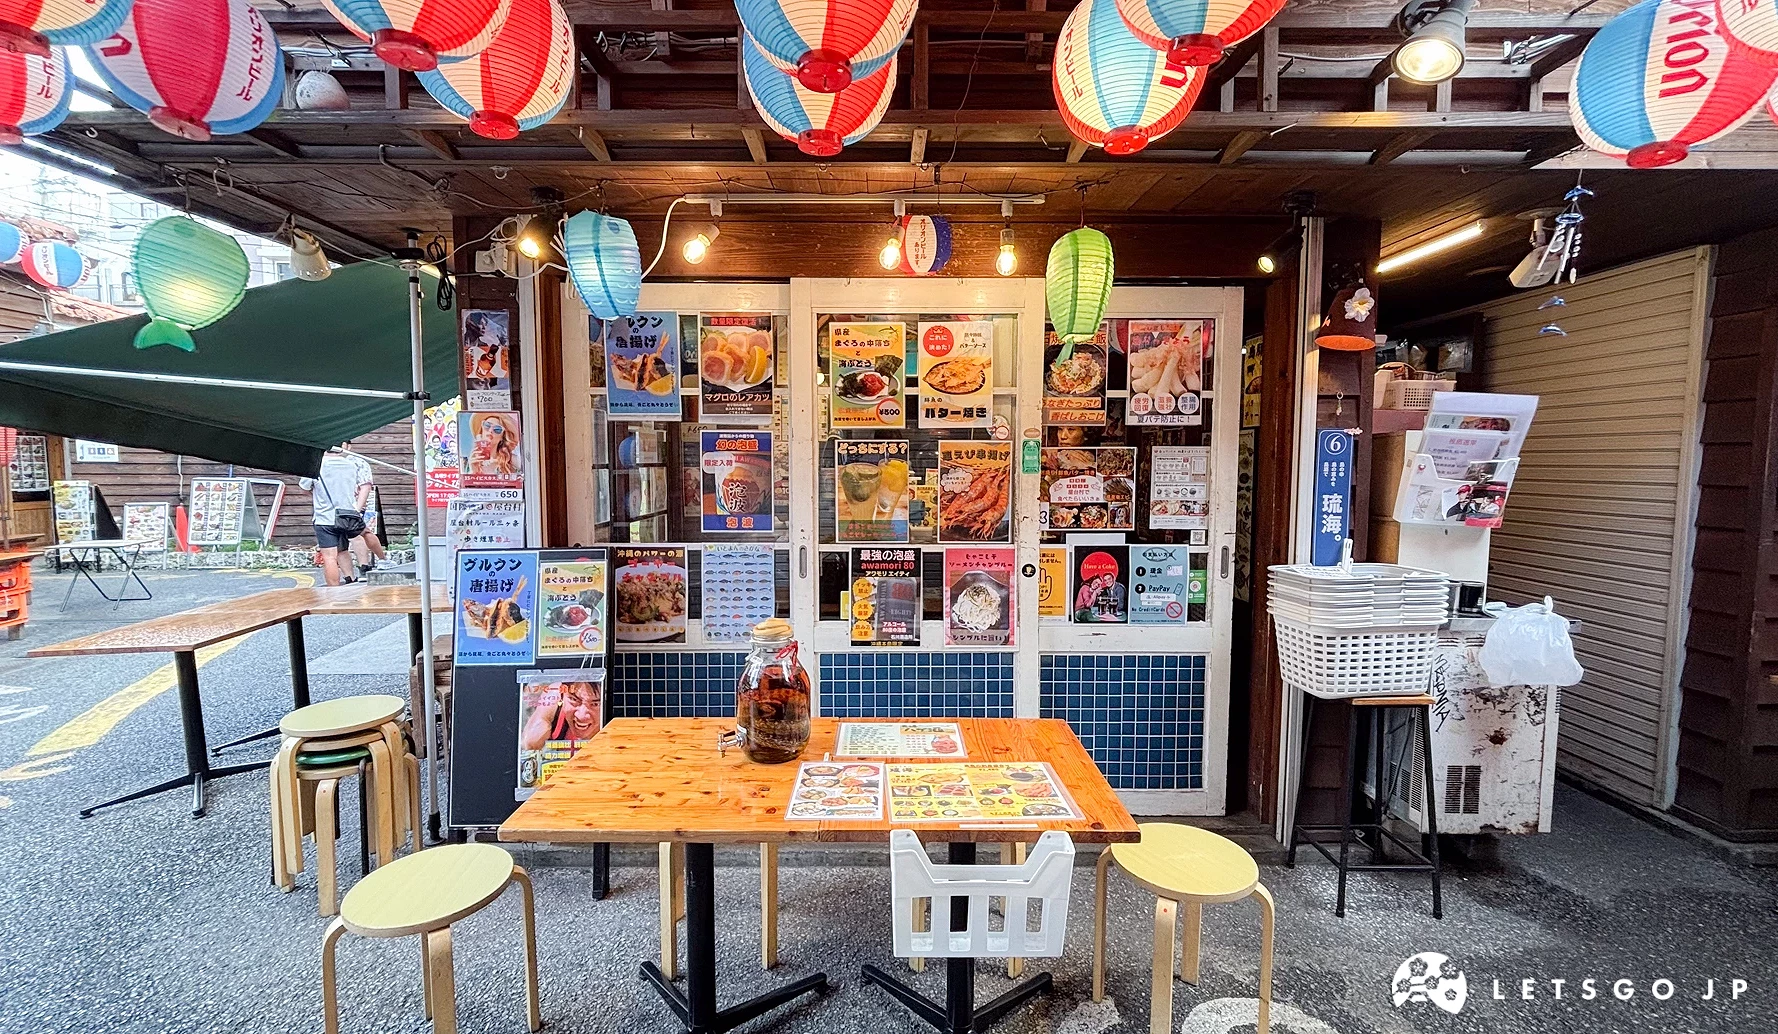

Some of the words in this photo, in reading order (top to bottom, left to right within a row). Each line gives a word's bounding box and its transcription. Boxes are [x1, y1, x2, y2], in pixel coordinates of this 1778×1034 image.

[1658, 0, 1714, 98] rion
[834, 328, 850, 336] 県産
[834, 339, 891, 348] まぐろの中落ち
[839, 359, 872, 368] 海ぶどう
[705, 393, 771, 402] マグロのレアカツ
[879, 408, 901, 416] ¥500
[924, 407, 987, 419] バター焼き
[1136, 416, 1191, 424] 夏バテ防止に！
[716, 438, 760, 451] 幻の泡盛
[838, 442, 909, 455] どっちにする？
[1330, 437, 1341, 452] 6
[704, 459, 734, 467] 限定入荷
[500, 490, 519, 499] 650
[1321, 494, 1343, 541] 琉海。
[617, 550, 685, 558] 沖縄のパワーの源
[860, 549, 916, 561] 最強の泡盛
[861, 561, 902, 570] awamori
[903, 561, 915, 570] 80
[949, 561, 1013, 569] ソーメンチャンプルー
[488, 570, 496, 578] の
[545, 576, 594, 584] まぐろの中落ち
[469, 578, 514, 593] 唐揚げ
[1148, 584, 1171, 593] PayPay
[547, 594, 577, 602] 海ぶどう
